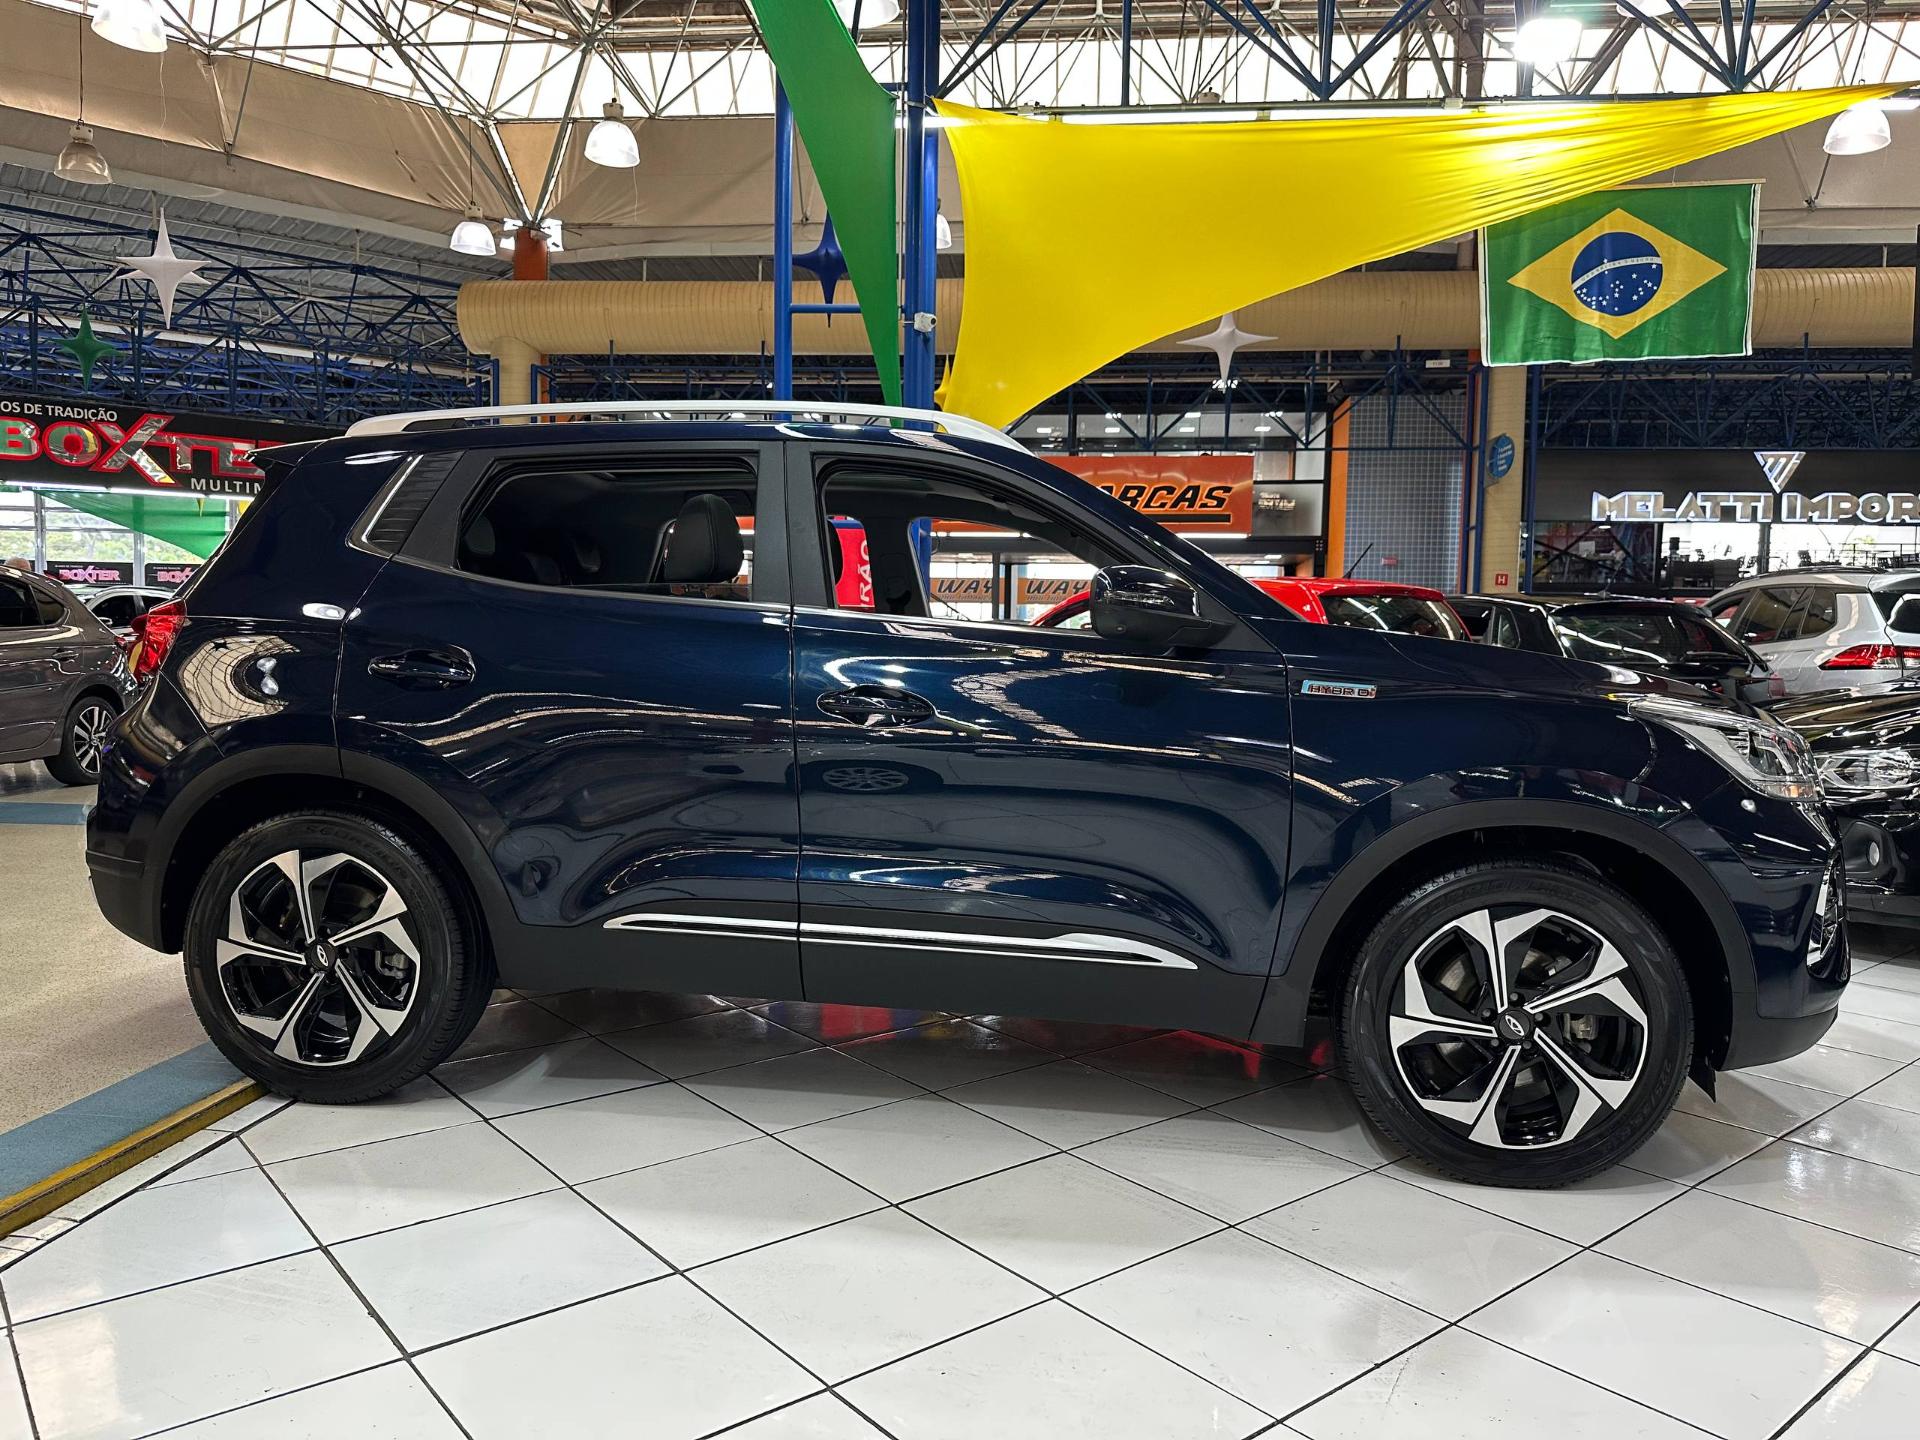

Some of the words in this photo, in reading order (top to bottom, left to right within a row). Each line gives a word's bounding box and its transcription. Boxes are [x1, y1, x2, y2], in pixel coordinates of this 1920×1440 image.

[24, 403, 42, 415] DE
[45, 405, 118, 423] TRADIÇÃO
[0, 413, 286, 487] BOXTE
[1100, 483, 1233, 510] RCAS
[1592, 491, 1774, 522] MELATTI
[1781, 492, 1920, 523] IMPOR
[59, 565, 121, 583] BOXTER
[1026, 580, 1088, 594] WAY
